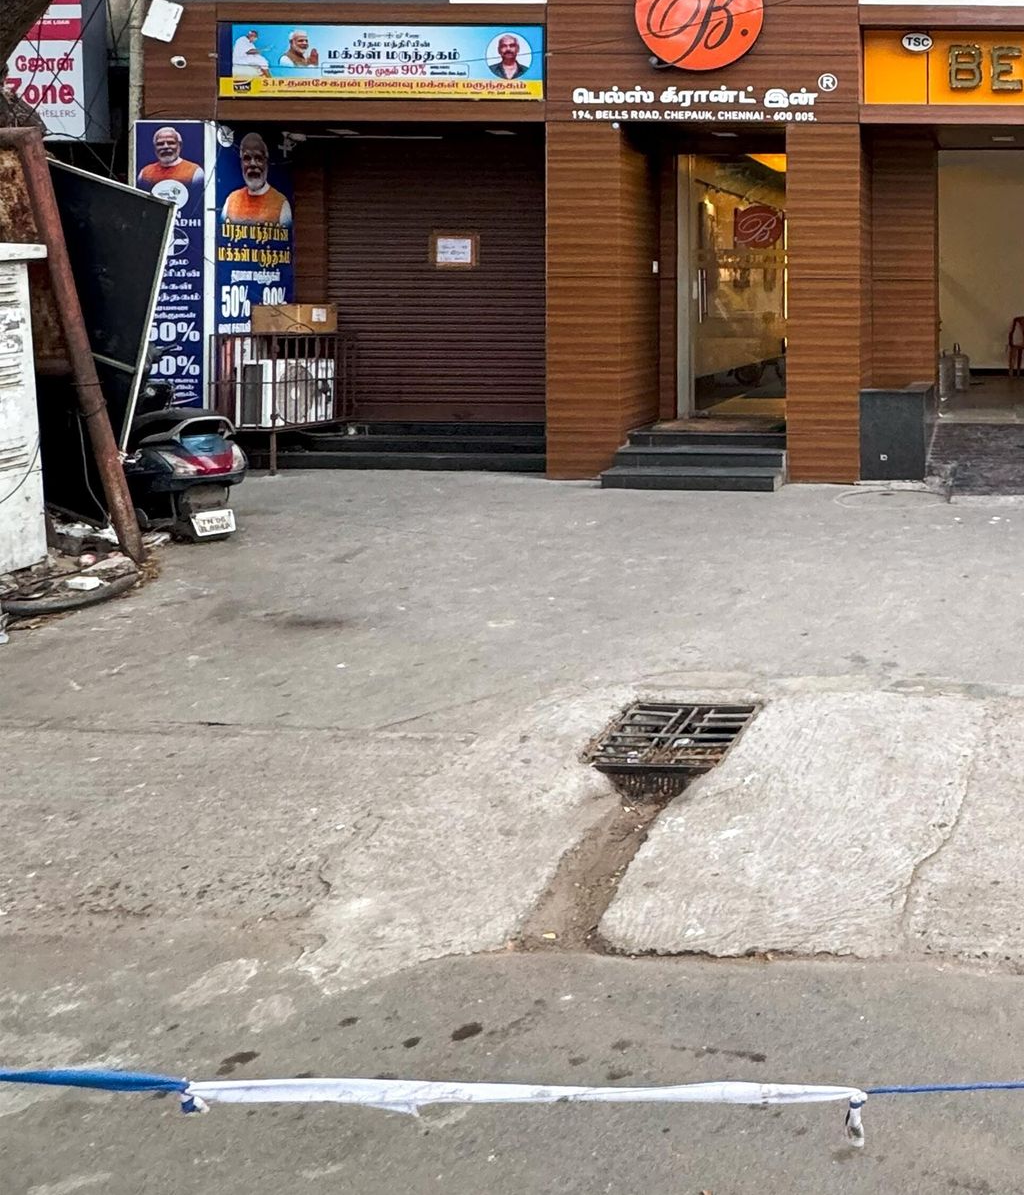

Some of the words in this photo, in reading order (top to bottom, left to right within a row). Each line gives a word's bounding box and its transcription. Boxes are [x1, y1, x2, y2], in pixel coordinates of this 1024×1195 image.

[905, 36, 930, 48] TSC
[327, 47, 381, 60] மக்கள்
[386, 48, 460, 63] மருந்தகம்
[347, 63, 373, 75] 50%
[401, 63, 427, 75] 90%
[572, 85, 655, 104] பெல்ஸ்
[763, 87, 819, 108] இன்
[38, 109, 76, 118] HEELERS
[572, 110, 594, 120] 194,
[595, 110, 629, 120] BELLS
[664, 110, 716, 121] CHEPAUK,
[717, 111, 764, 121] CHENNAI
[773, 111, 792, 121] 600
[218, 243, 250, 262] மக்கள்
[251, 246, 291, 267] மருந்தகம்
[222, 285, 251, 318] 50%
